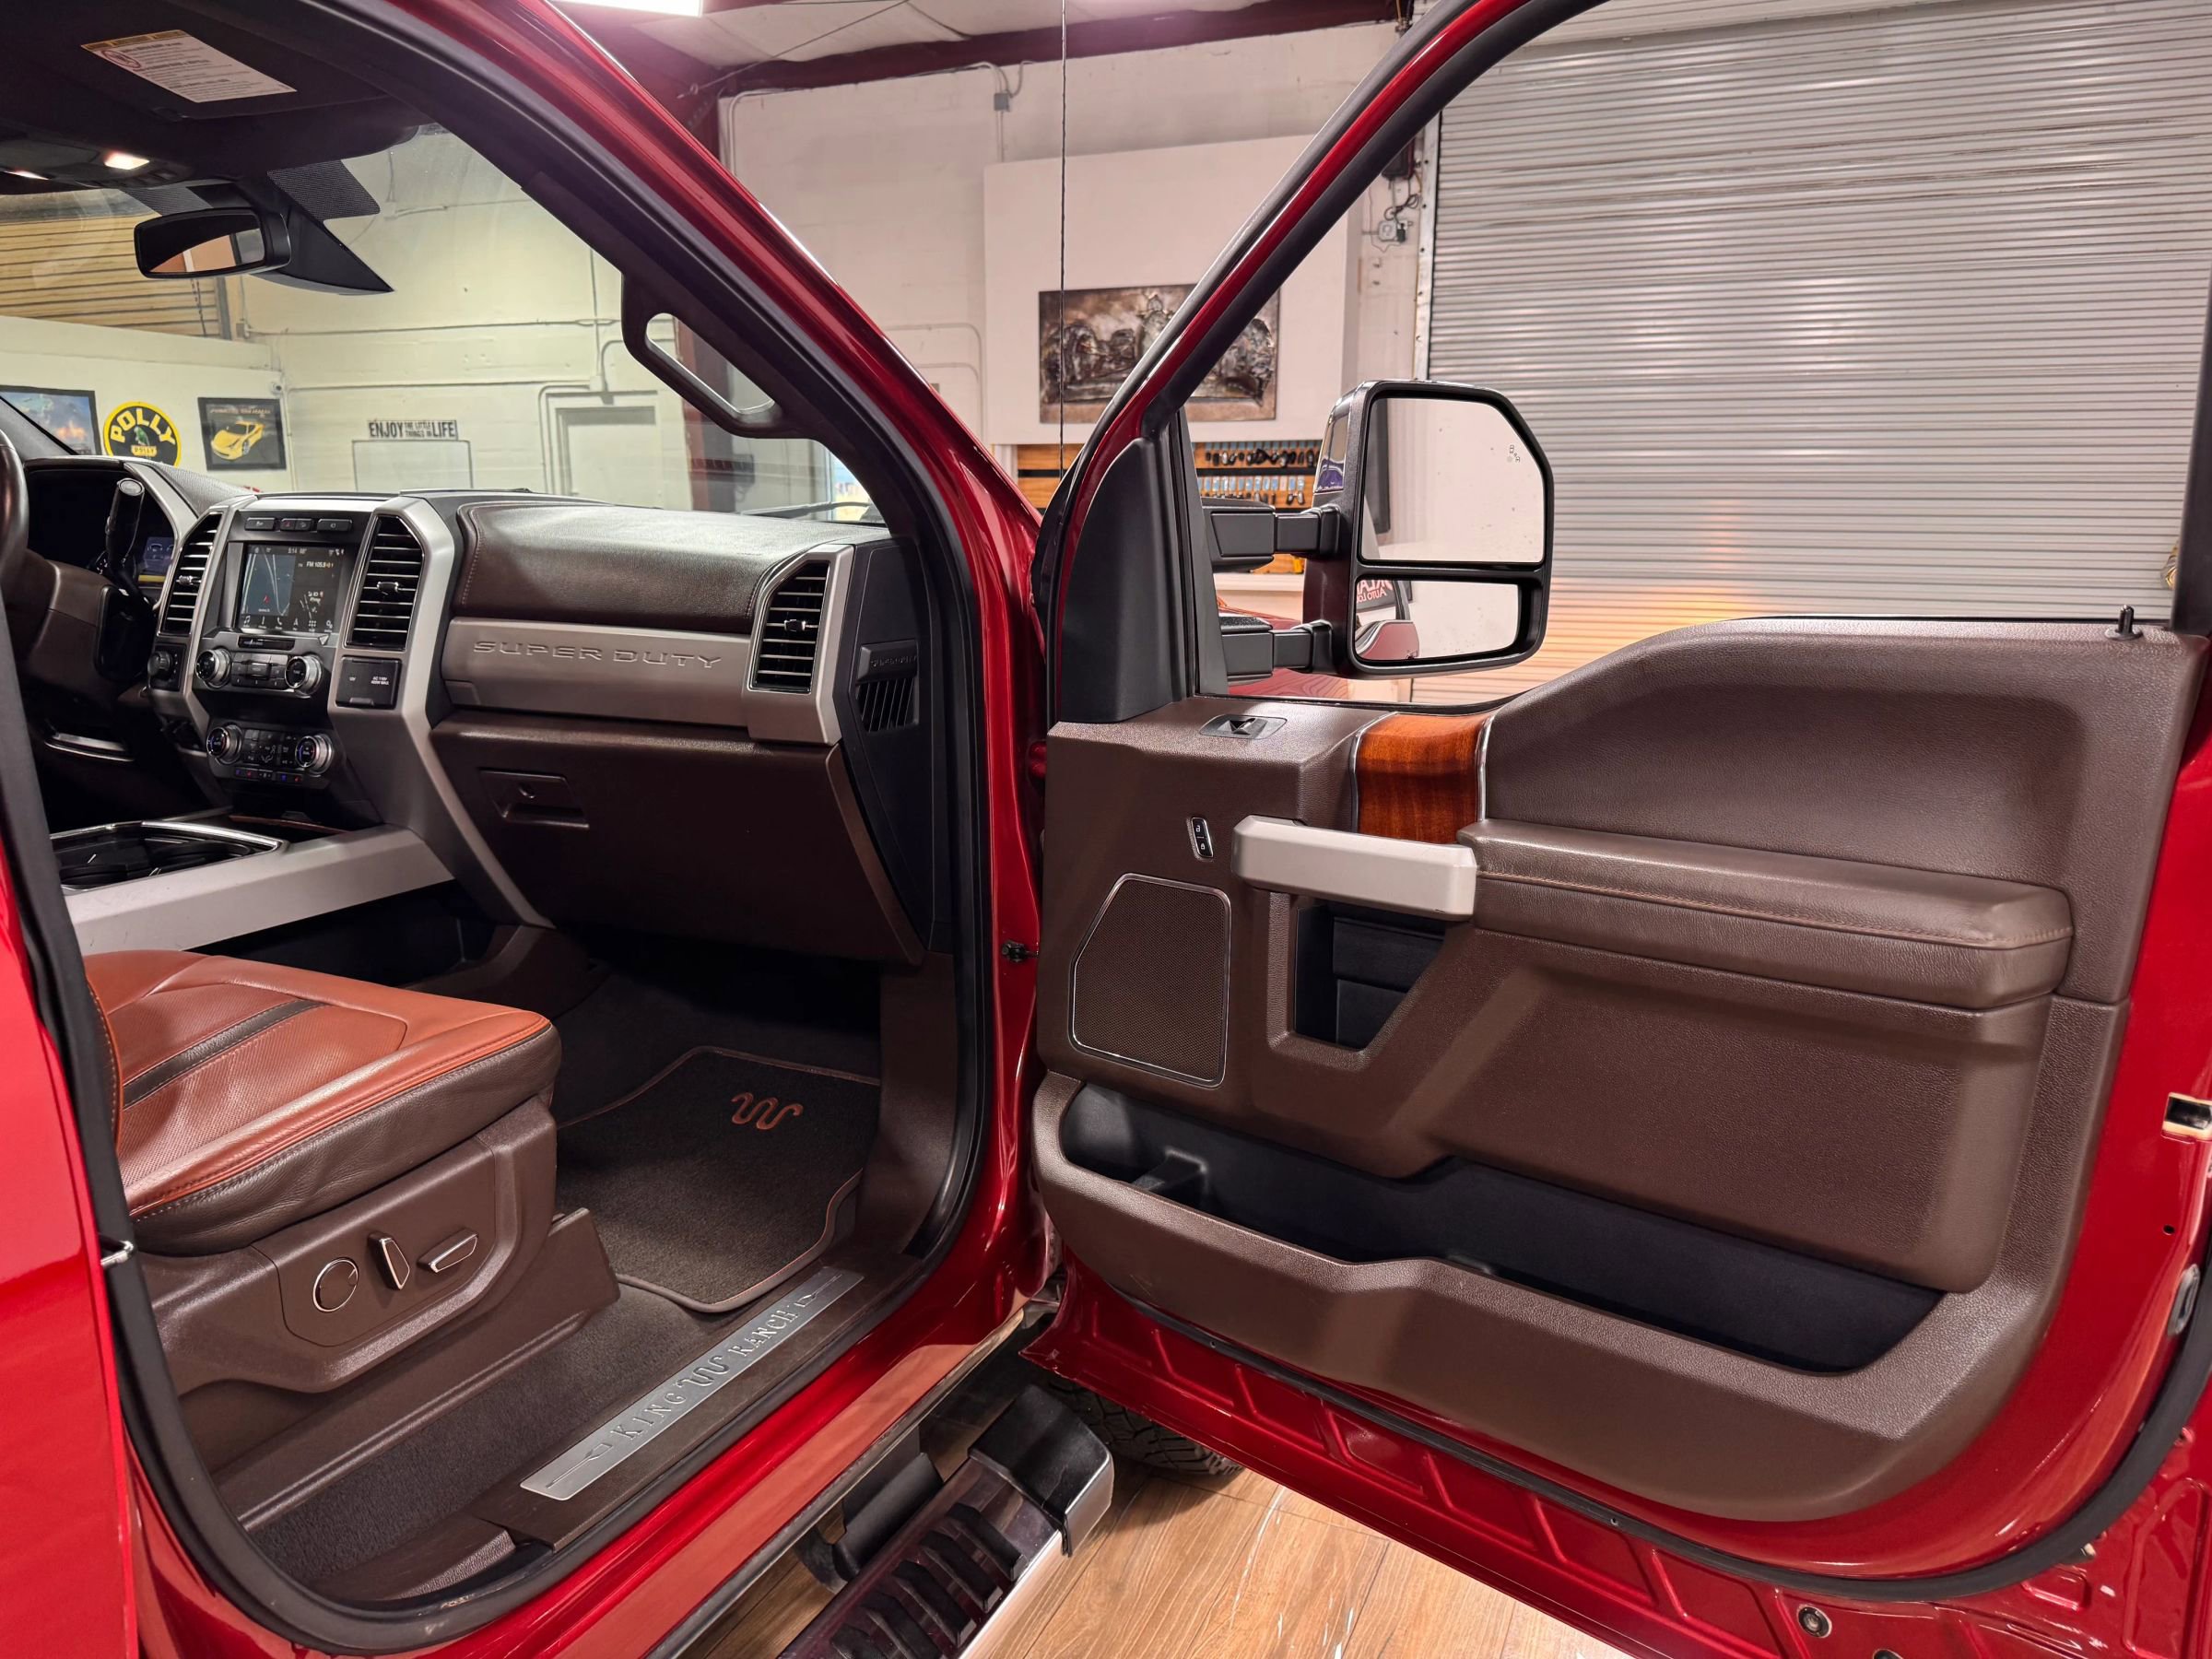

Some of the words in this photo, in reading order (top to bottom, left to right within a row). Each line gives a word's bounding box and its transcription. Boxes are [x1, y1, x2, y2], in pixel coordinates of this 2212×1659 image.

[111, 408, 176, 444] POLLY
[369, 422, 403, 438] ENJOY
[432, 421, 456, 437] LIFE
[473, 640, 603, 661] SUPER
[612, 649, 723, 669] DUTY
[609, 1392, 687, 1441] KING
[726, 1305, 799, 1358] RANCH
